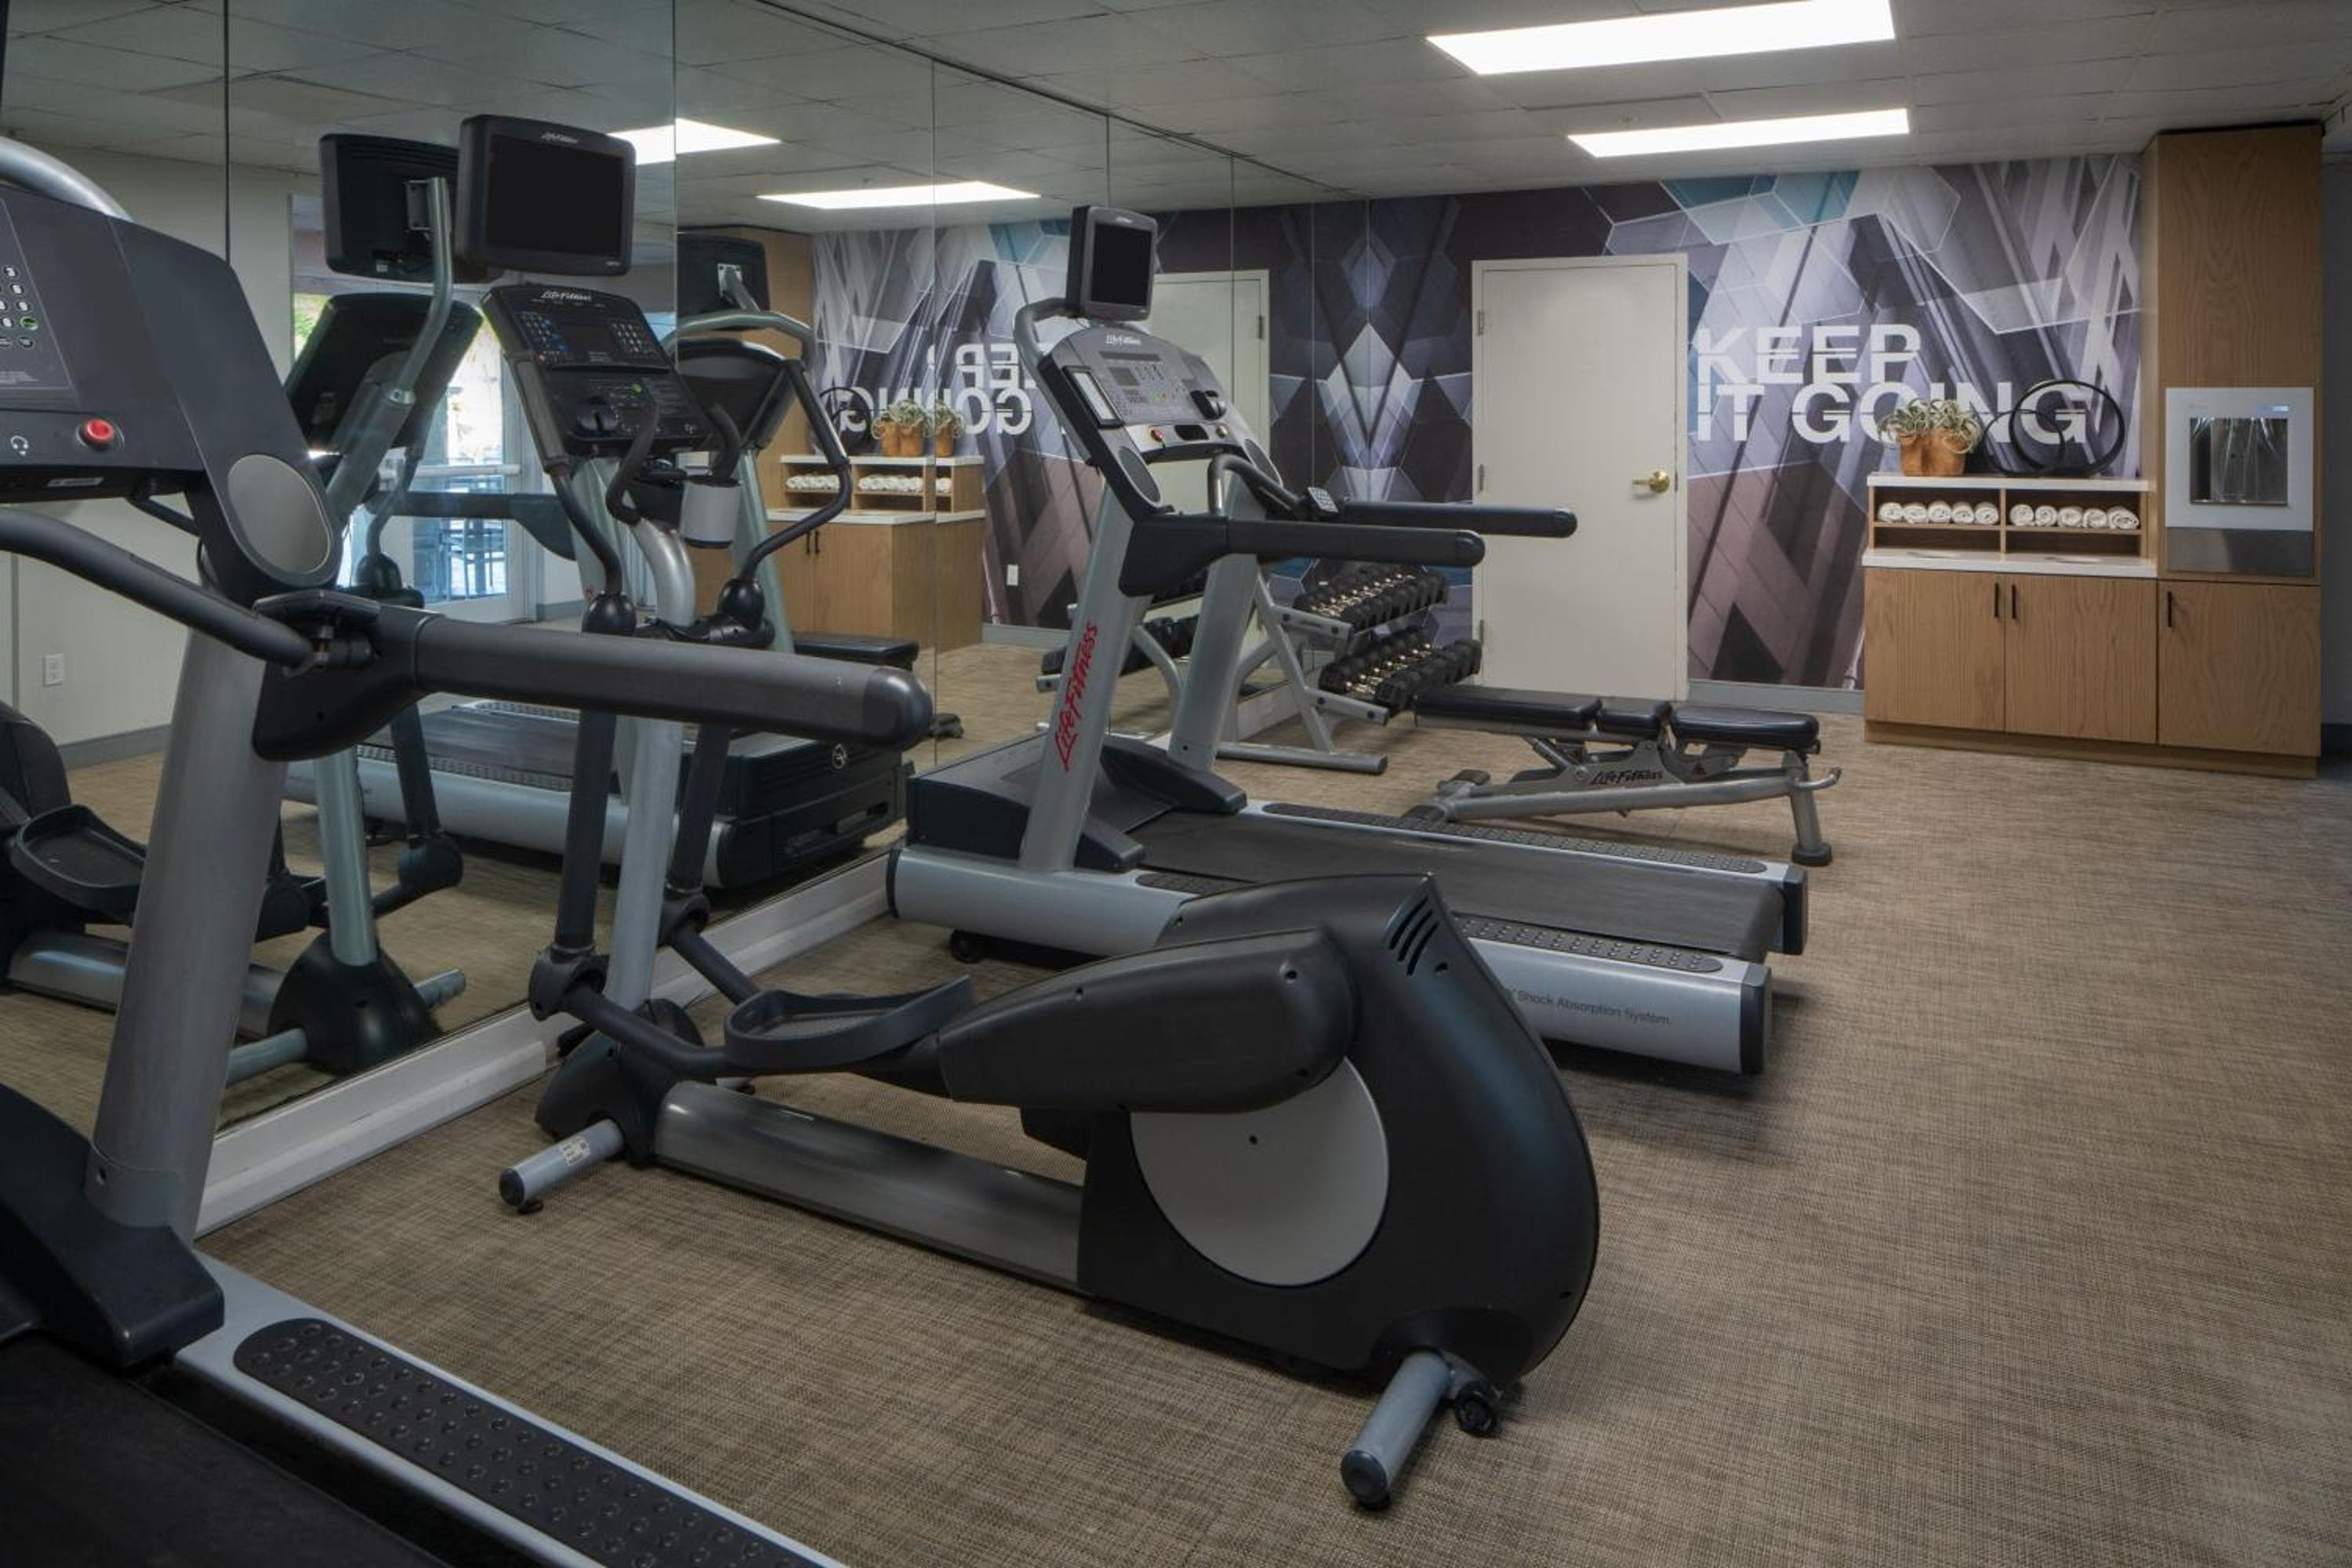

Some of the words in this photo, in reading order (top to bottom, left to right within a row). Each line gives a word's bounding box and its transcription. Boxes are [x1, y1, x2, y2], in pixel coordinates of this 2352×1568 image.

[1697, 324, 1922, 384] KEEP
[1697, 383, 1765, 442] IT
[1517, 990, 1553, 1005] Shock
[1556, 995, 1621, 1018] Absorption
[1624, 1007, 1670, 1025] System
